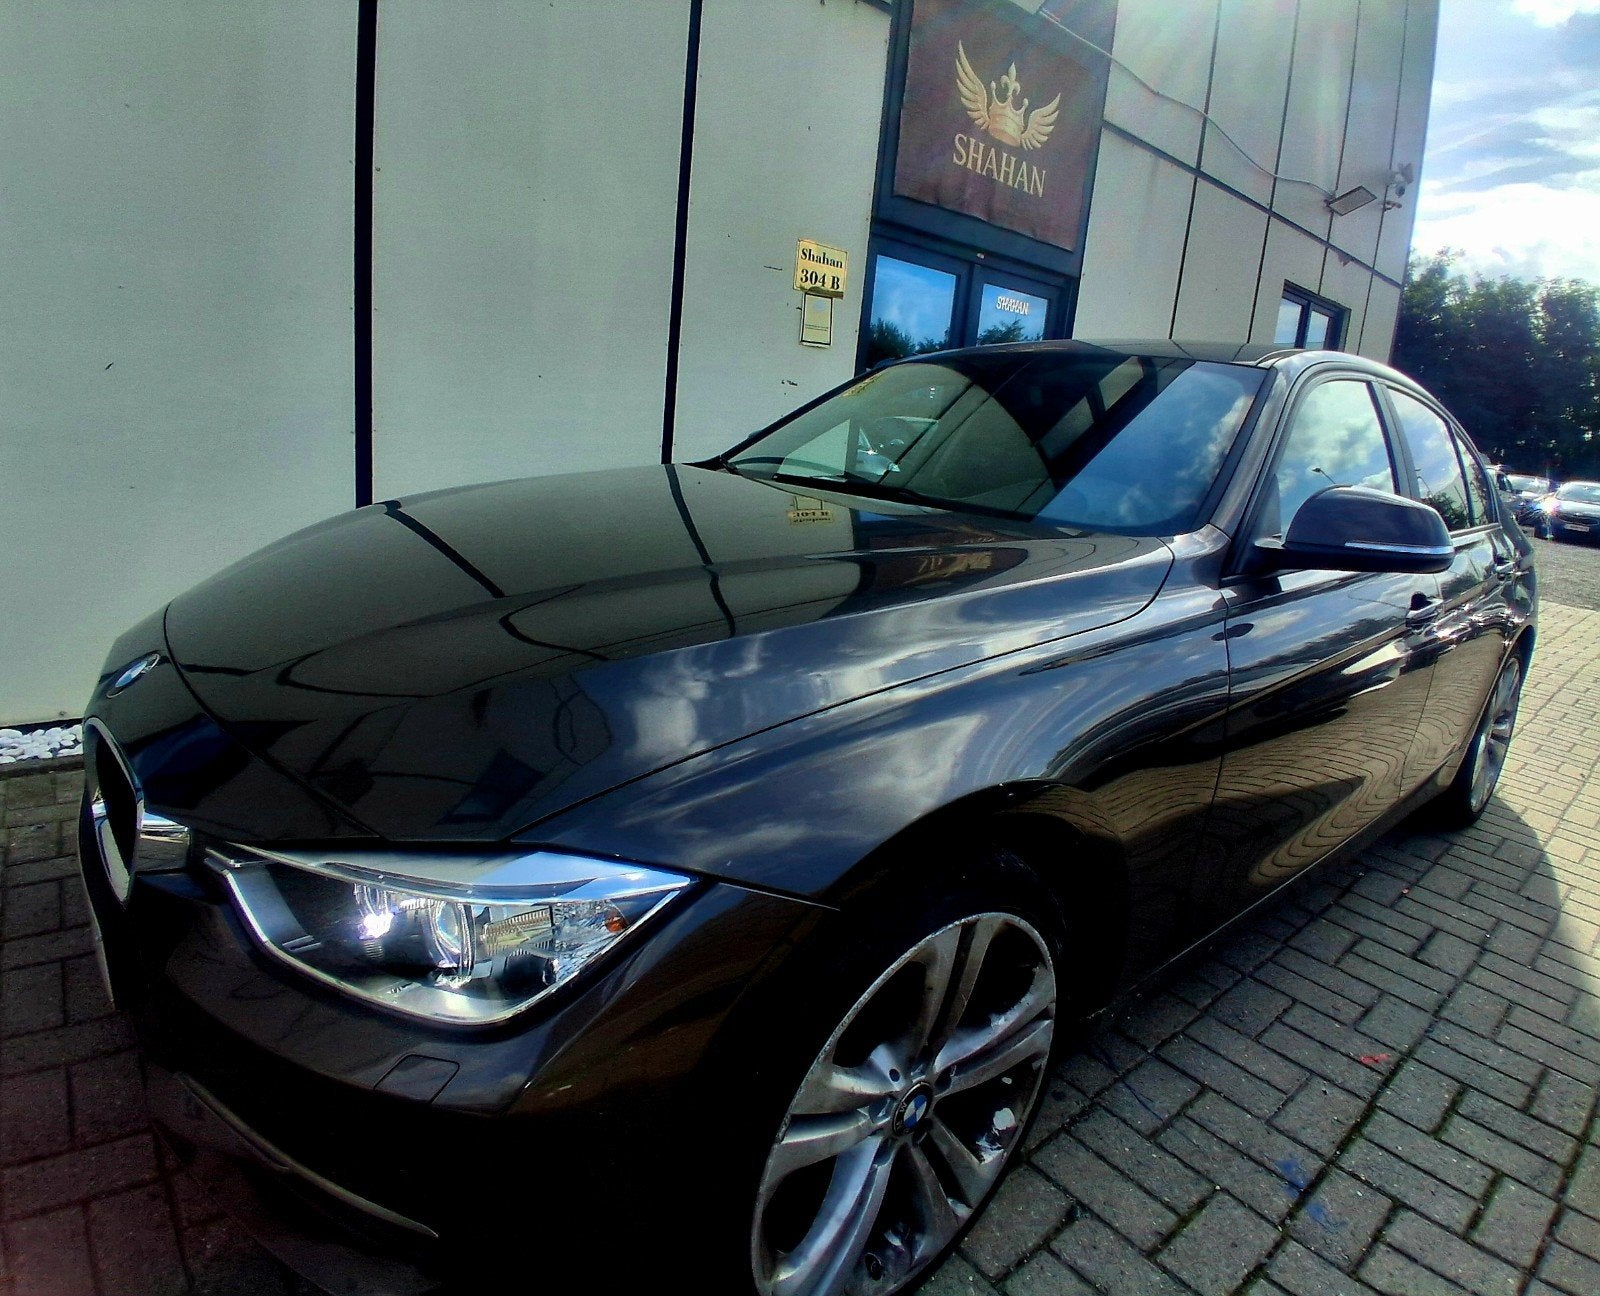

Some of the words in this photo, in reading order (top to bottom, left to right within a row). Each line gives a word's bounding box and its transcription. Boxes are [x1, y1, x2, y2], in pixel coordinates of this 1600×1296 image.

[953, 133, 1046, 198] SHAHAN
[800, 247, 843, 269] Shahan
[800, 268, 826, 288] 304
[831, 275, 840, 290] B
